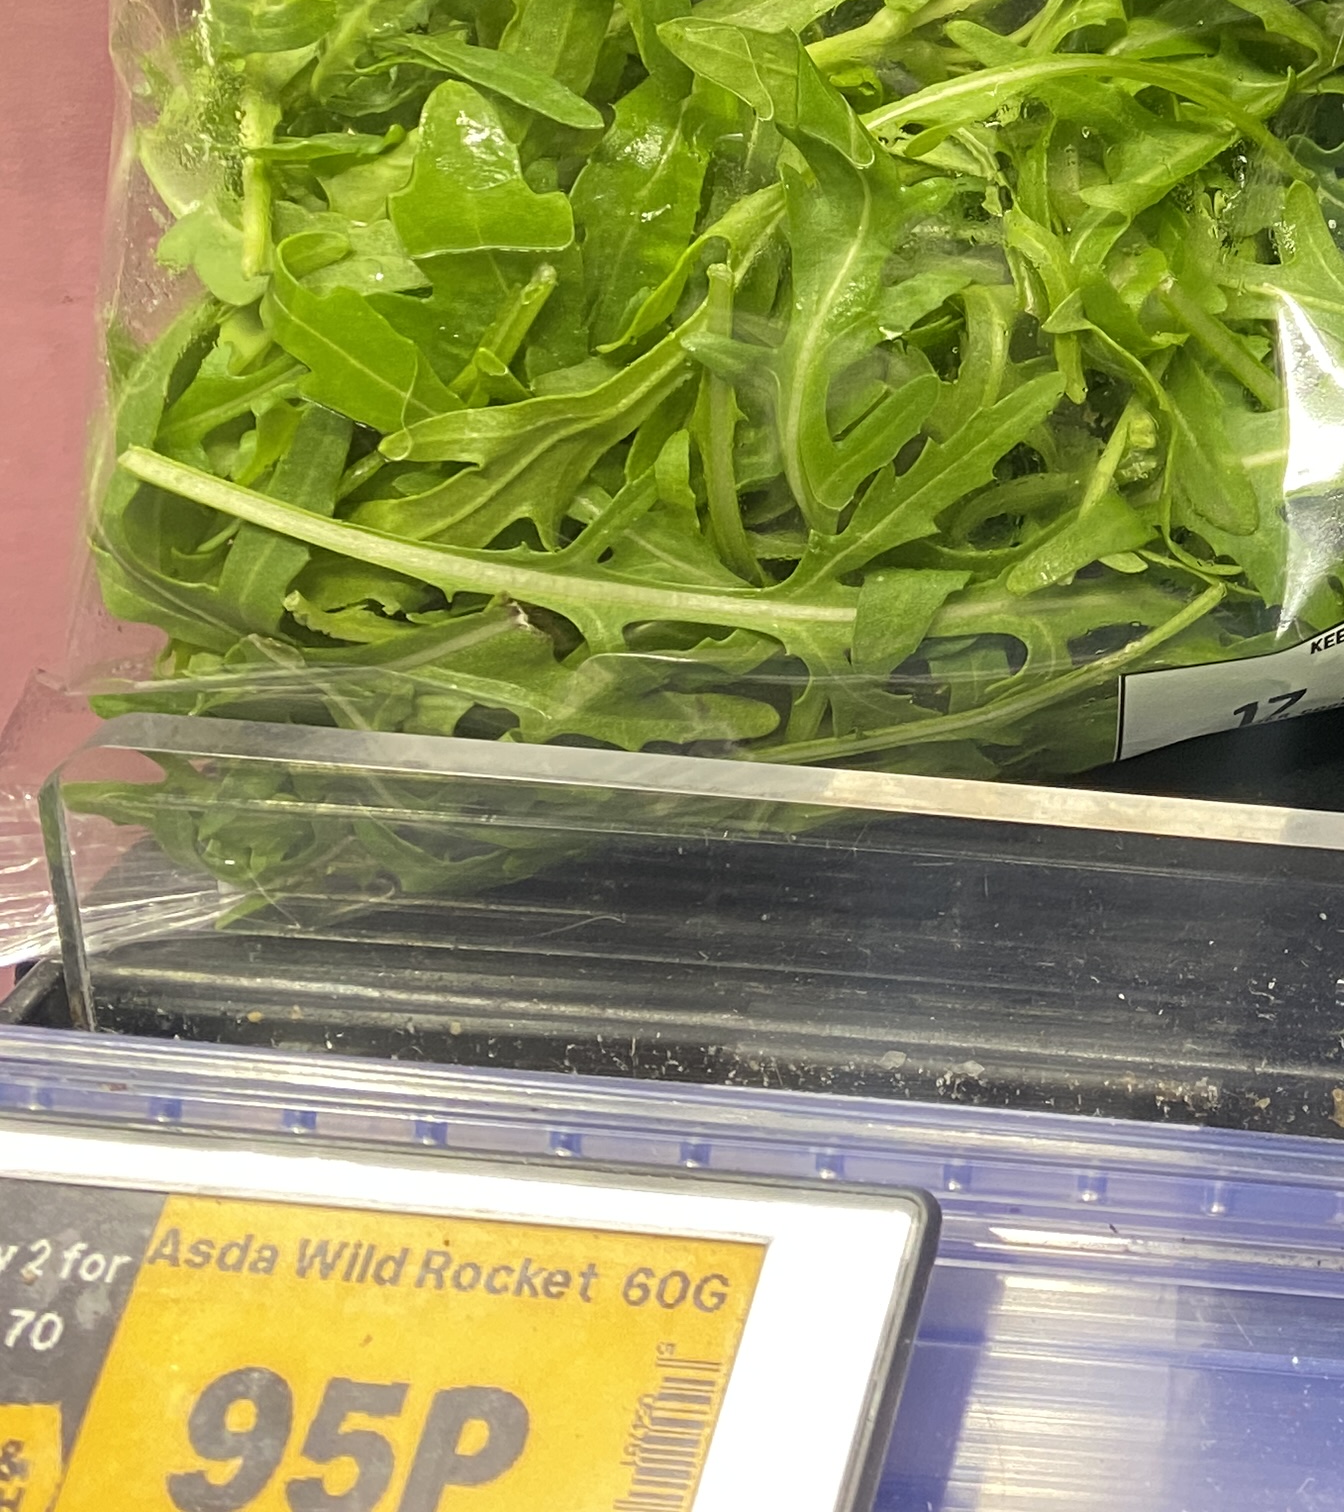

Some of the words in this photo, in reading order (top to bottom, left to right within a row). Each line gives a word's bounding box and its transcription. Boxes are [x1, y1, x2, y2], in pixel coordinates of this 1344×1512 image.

[21, 1239, 52, 1277] 2
[59, 1242, 132, 1283] for
[147, 1227, 279, 1278] Asda
[295, 1238, 406, 1288] Wild
[417, 1249, 598, 1304] Rocket
[623, 1270, 730, 1314] 60G
[165, 1365, 530, 1512] 95P
